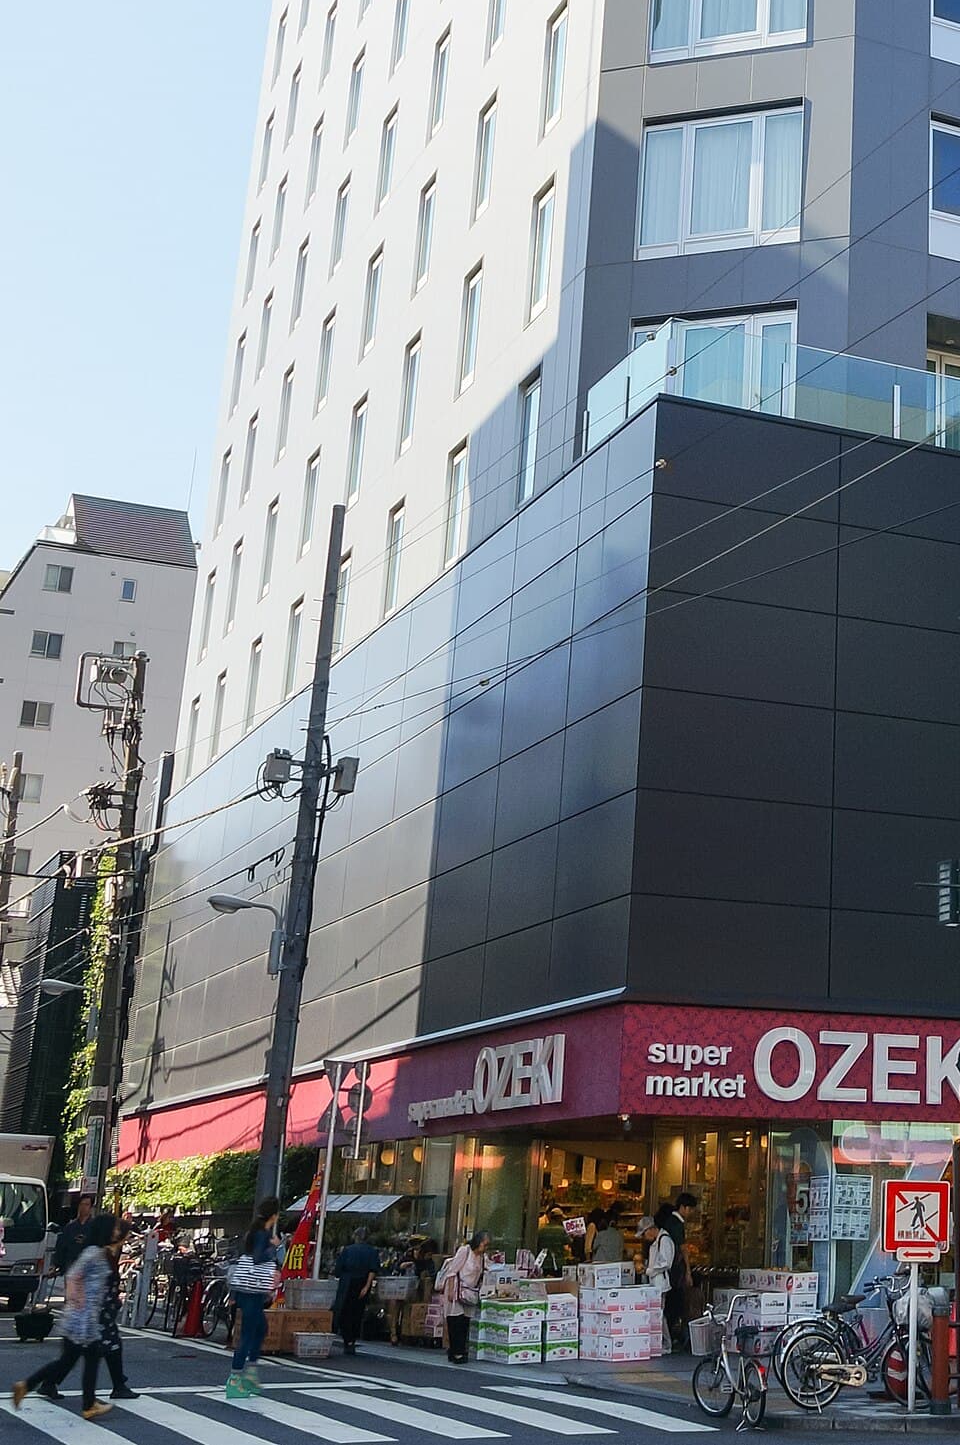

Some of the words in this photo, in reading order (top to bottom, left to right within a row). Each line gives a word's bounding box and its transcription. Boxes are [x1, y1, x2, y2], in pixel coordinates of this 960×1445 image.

[648, 1042, 732, 1071] super
[473, 1034, 566, 1114] OZEKI
[645, 1072, 746, 1099] market
